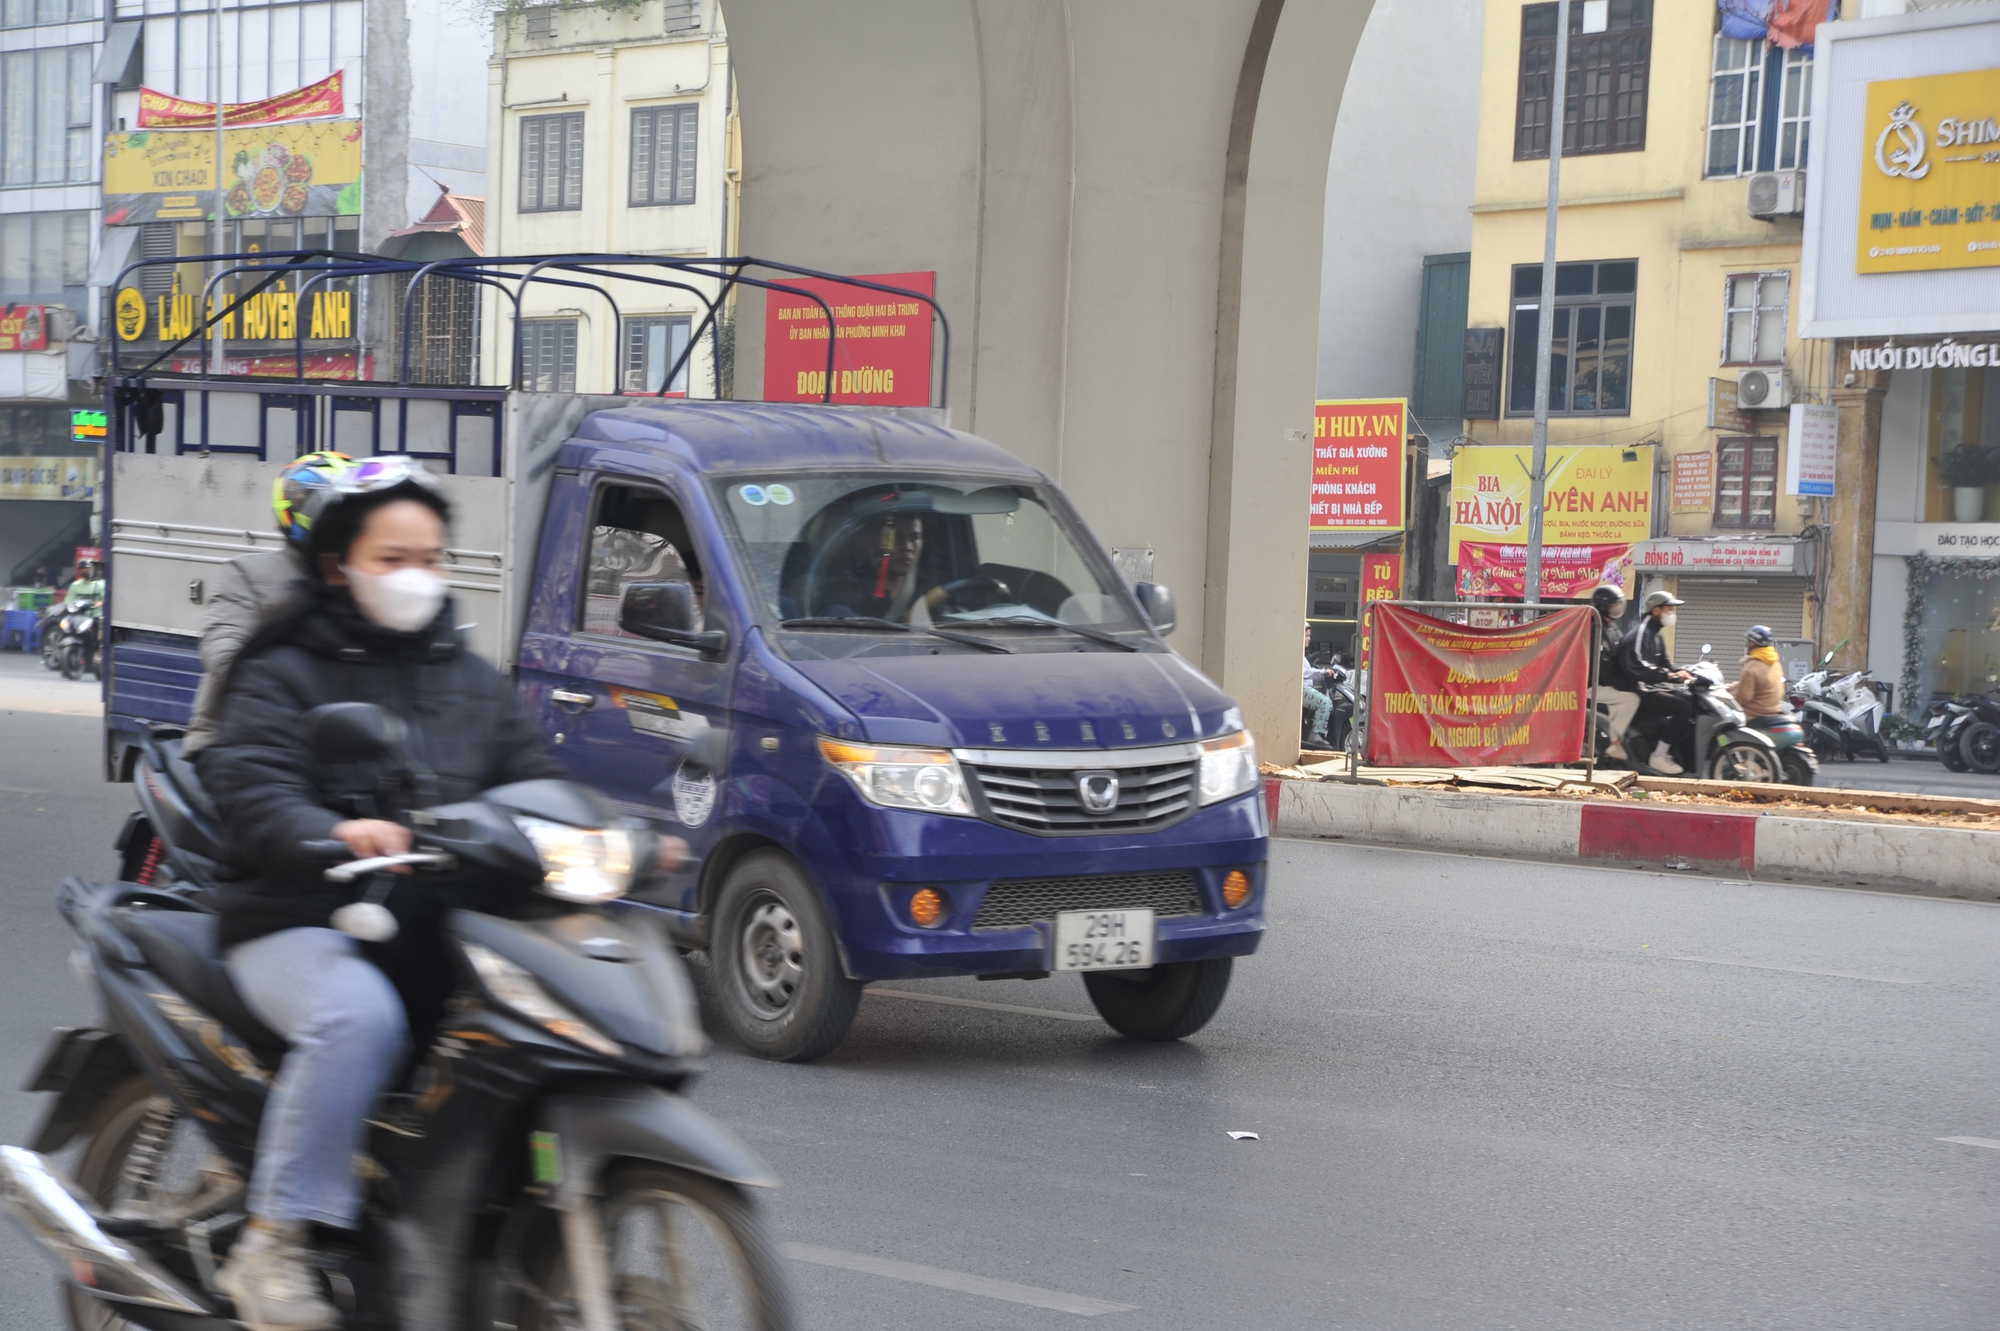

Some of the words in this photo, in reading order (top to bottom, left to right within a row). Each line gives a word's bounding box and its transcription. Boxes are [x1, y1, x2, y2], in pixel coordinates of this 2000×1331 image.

[310, 292, 351, 338] ANH
[778, 308, 792, 320] BAN
[792, 308, 801, 319] AN
[802, 306, 819, 320] TOÀN
[835, 304, 856, 318] THÔNG
[857, 303, 874, 320] QUẬN
[875, 305, 887, 317] HAI
[887, 302, 897, 317] BÀ
[789, 324, 799, 340] ỦY
[799, 328, 812, 340] BAN
[813, 325, 830, 340] NHÂN
[845, 325, 871, 339] PHƯỜNG
[872, 326, 889, 338] MINH
[890, 325, 906, 337] KHAI
[1850, 342, 1904, 371] NUÔI
[841, 366, 894, 394] ĐƯỜNG
[1466, 390, 1491, 411] ANH
[1330, 414, 1398, 438] HUY.VN
[1315, 444, 1337, 459] THẤT
[1339, 446, 1355, 459] GIÁ
[1356, 444, 1388, 459] XƯỞNG
[1315, 464, 1340, 476] MIỄN
[1342, 464, 1359, 476] PHÍ
[1575, 468, 1596, 482] ĐẠI
[1599, 465, 1613, 480] LÝ
[1312, 480, 1343, 495] PHÒNG
[1345, 480, 1376, 495] KHÁCH
[1478, 475, 1501, 493] BIA
[1331, 503, 1341, 517] BỊ
[1343, 501, 1362, 515] NHÀ
[1364, 500, 1383, 515] BẾP
[1600, 491, 1649, 513] ANH
[1455, 495, 1483, 525] HÀ
[1486, 496, 1523, 532] NỘI
[1543, 519, 1557, 528] ƯỢU,
[1559, 520, 1571, 528] BIA,
[1572, 519, 1589, 527] NƯỚC
[1590, 520, 1608, 528] NGỌT,
[1609, 519, 1631, 528] ĐƯỜNG
[1633, 519, 1645, 528] SỮA
[1560, 530, 1576, 538] BÁNH
[1592, 530, 1613, 539] THUỐC
[1614, 530, 1622, 538] LÁ
[1938, 533, 1957, 546] ĐÀO
[1960, 535, 1978, 549] TẠO
[1980, 535, 2000, 549] HỌC
[1499, 545, 1515, 558] CÔNG
[1644, 545, 1669, 565] ĐỒNG
[1671, 546, 1684, 565] HỒ
[1373, 561, 1391, 580] TỦ
[1492, 566, 1517, 579] Chúc
[1548, 581, 1569, 594] 2025
[1475, 619, 1493, 627] STOP
[1451, 640, 1471, 649] NHÂN
[1471, 640, 1485, 649] DÂN
[1384, 688, 1427, 714] THƯỜNG
[1430, 688, 1453, 715] XẢY
[1454, 695, 1469, 715] RA
[1471, 695, 1489, 715] TAI
[1490, 694, 1513, 719] NẠN
[1515, 694, 1542, 713] GIAO
[1484, 723, 1499, 751] BỘ
[1502, 722, 1530, 745] HÀNH
[1083, 913, 1127, 939] 29H
